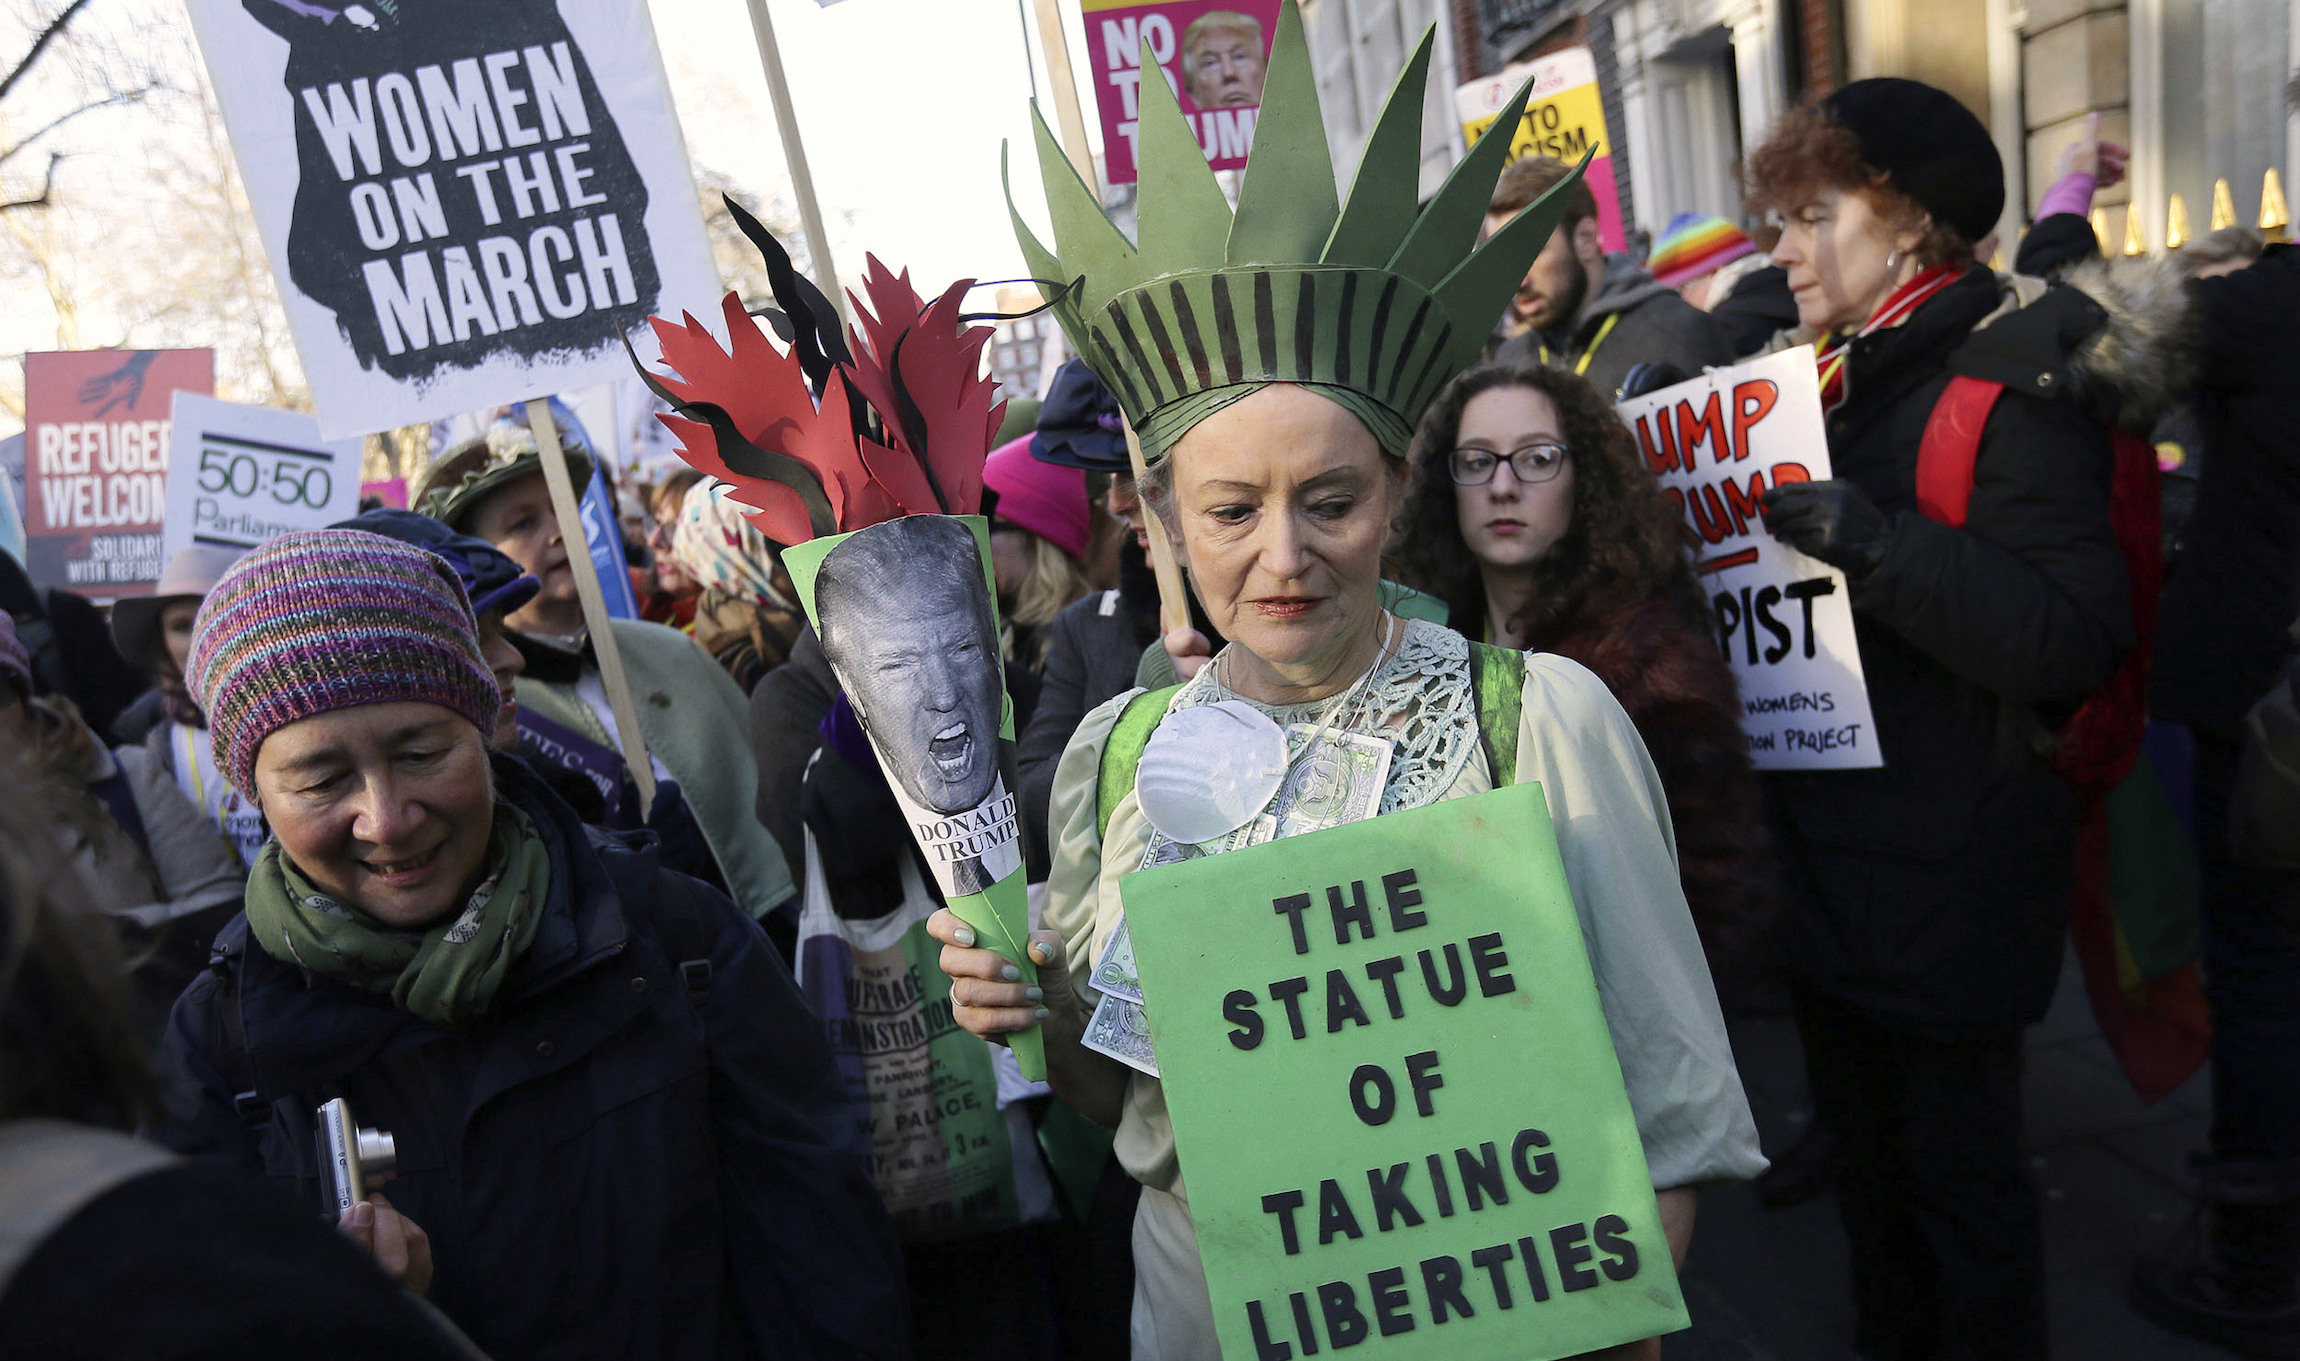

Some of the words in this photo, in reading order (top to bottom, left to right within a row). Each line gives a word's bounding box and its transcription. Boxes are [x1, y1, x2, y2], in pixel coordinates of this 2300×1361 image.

[1101, 12, 1176, 70] NO
[302, 40, 592, 181] WOMEN
[1108, 66, 1179, 120] T
[1523, 104, 1559, 135] TO
[350, 172, 449, 251] ON
[456, 142, 608, 226] THE
[361, 213, 638, 356] MARCH
[1635, 378, 1779, 474] UMP
[198, 449, 332, 510] 50:50
[92, 534, 163, 561] SOLIDARI
[193, 497, 298, 538] Parliam
[67, 561, 107, 584] WITH
[110, 559, 163, 583] REFUGE
[1713, 577, 1836, 666] PIST
[1746, 691, 1835, 715] WOMENS
[1785, 724, 1861, 753] PROJECT
[917, 797, 1013, 841] DONALD
[933, 820, 1015, 862] TRUMP
[1273, 868, 1427, 954] THE
[1222, 932, 1516, 1050] STATUE
[1349, 1050, 1443, 1126] OF
[1261, 1128, 1559, 1255] TAKING
[1246, 1213, 1639, 1361] LIBERTIES
